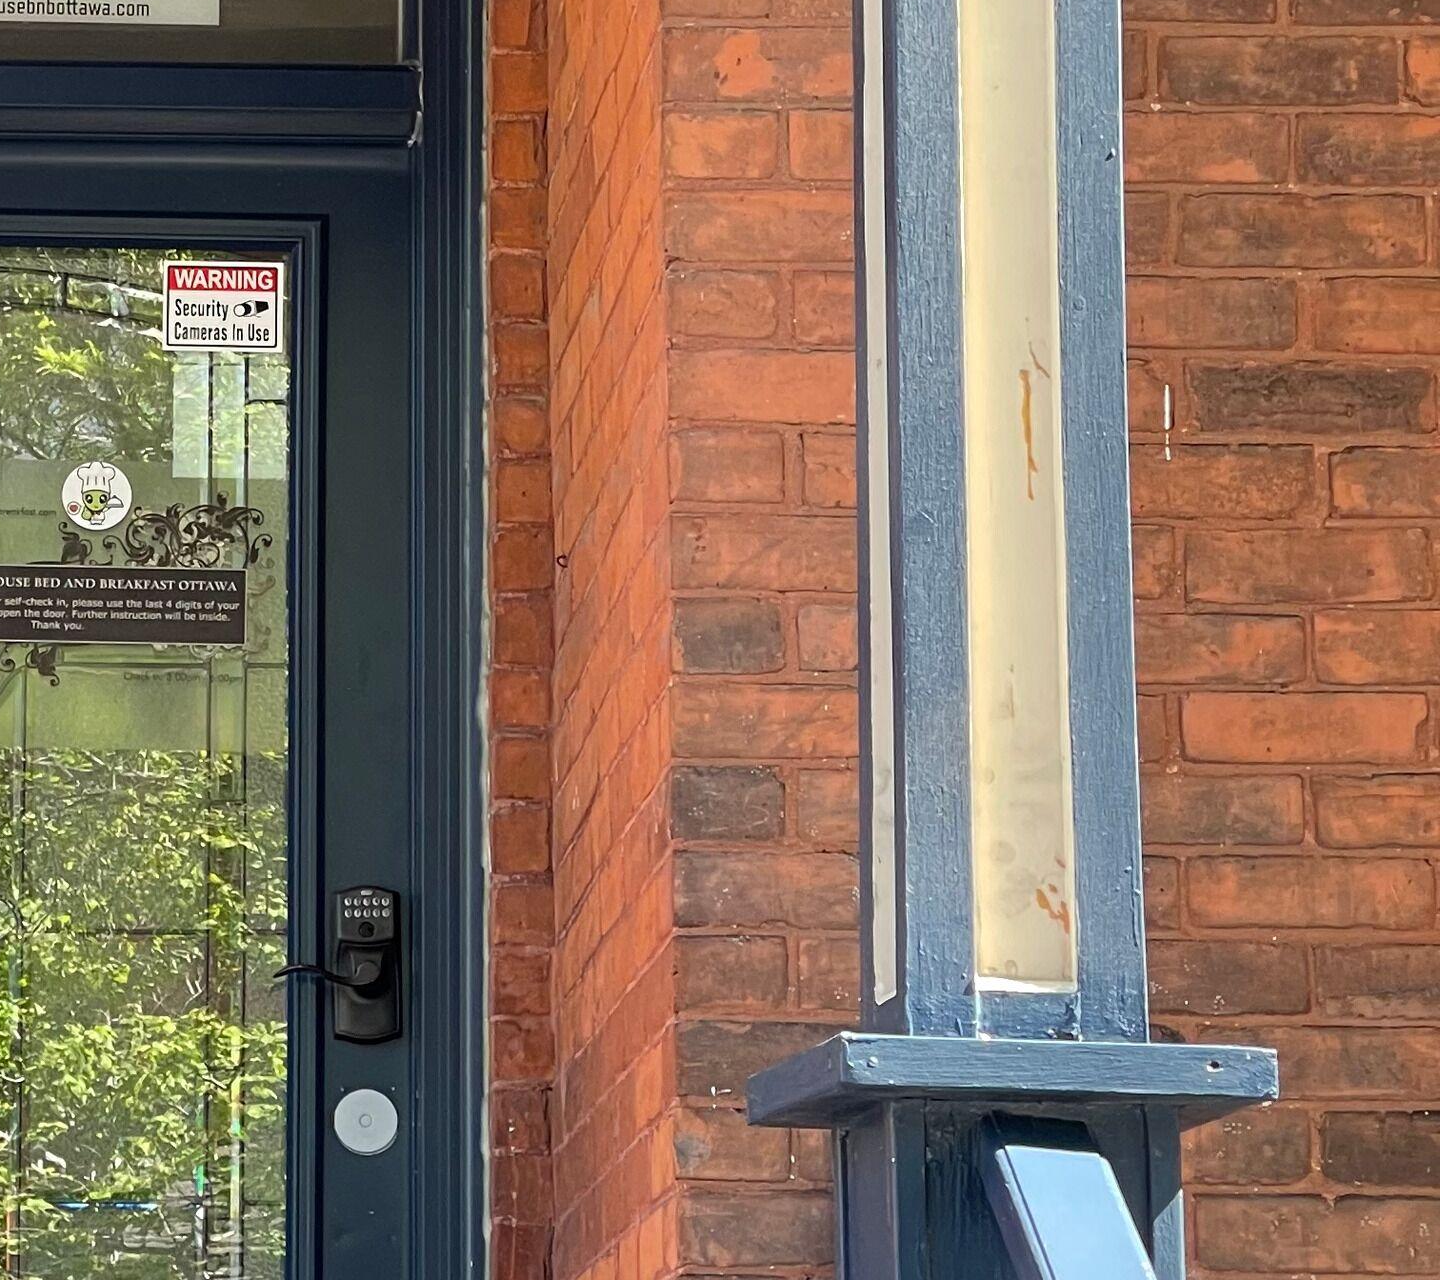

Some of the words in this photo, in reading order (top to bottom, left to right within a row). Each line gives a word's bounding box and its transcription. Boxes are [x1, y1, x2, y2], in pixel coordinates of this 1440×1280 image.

[174, 269, 273, 290] WARNING
[175, 299, 229, 321] Security
[174, 322, 228, 341] Cameras
[232, 324, 244, 341] In
[248, 324, 269, 342] Use
[34, 577, 61, 588] BED
[64, 578, 96, 589] AND
[99, 578, 176, 591] BREAKFAST
[178, 580, 238, 592] OTTAWA
[4, 597, 53, 606] self-check
[56, 599, 69, 609] in,
[72, 599, 104, 609] please
[106, 600, 124, 608] use
[126, 600, 142, 608] the
[145, 600, 163, 609] last
[165, 600, 172, 608] 4
[175, 600, 202, 611] digits
[204, 601, 215, 610] of
[217, 602, 240, 612] your
[24, 609, 40, 618] the
[42, 610, 68, 619] door.
[72, 610, 108, 619] Further
[110, 610, 162, 620] instruction
[164, 611, 181, 620] will
[184, 611, 196, 620] be
[198, 612, 231, 622] inside.
[31, 620, 61, 630] Thank
[64, 622, 85, 632] you.
